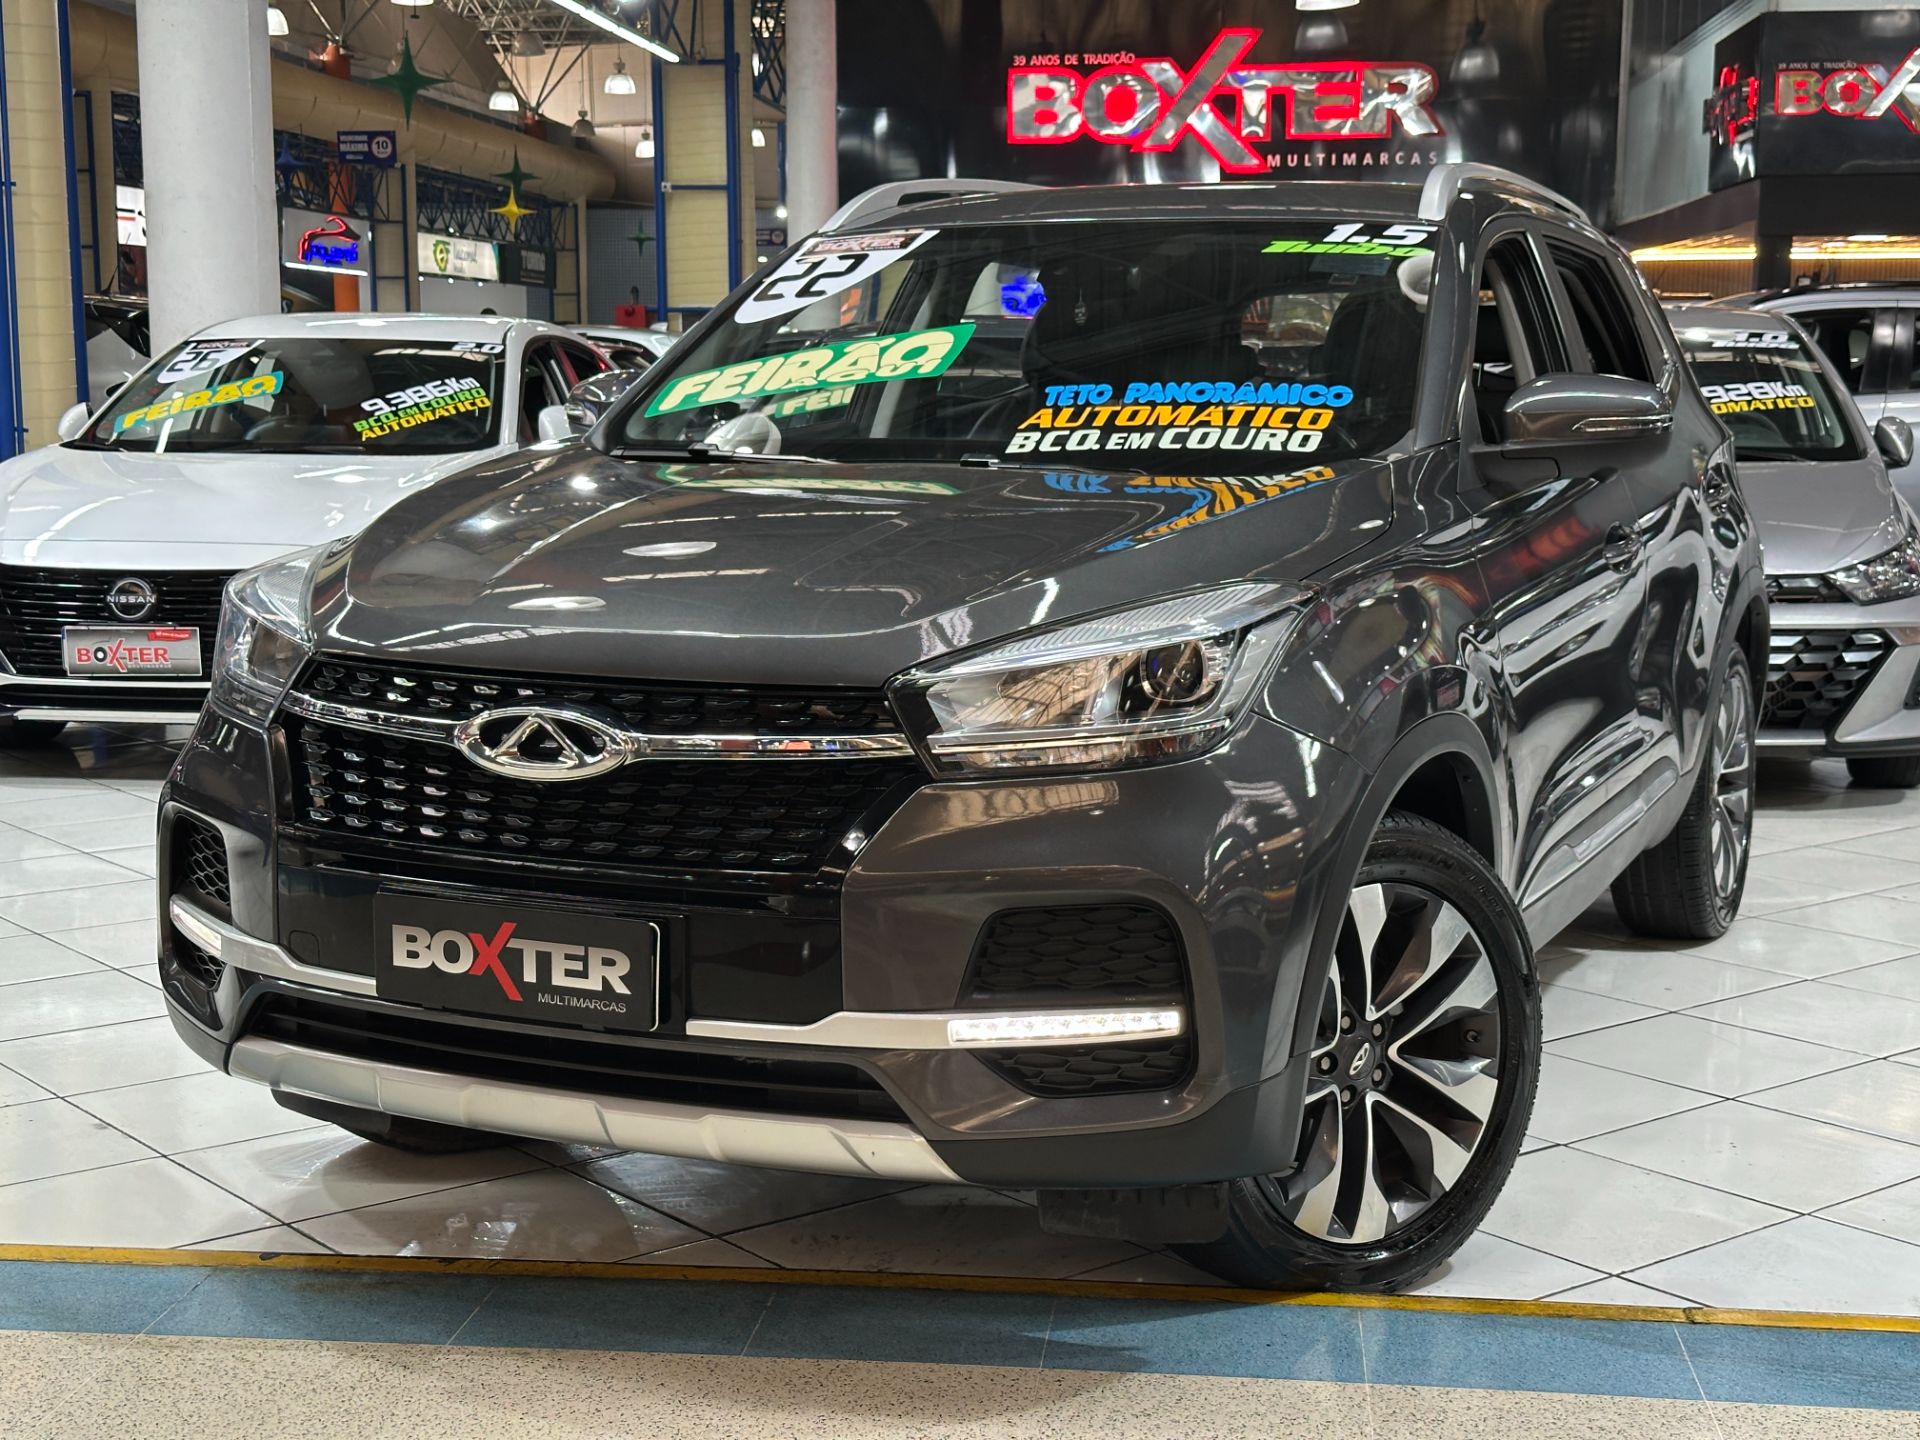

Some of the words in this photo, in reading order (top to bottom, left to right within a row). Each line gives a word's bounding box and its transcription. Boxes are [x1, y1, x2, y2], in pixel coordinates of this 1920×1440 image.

[1013, 55, 1026, 65] 39
[1030, 54, 1060, 65] ANOS
[1064, 54, 1079, 65] DE
[1084, 52, 1135, 66] TRADIÇÃO
[1007, 27, 1445, 173] BOXTER
[375, 140, 388, 150] 10
[1267, 152, 1438, 167] MULTIMARCAS
[1323, 223, 1438, 245] 1.5
[752, 252, 870, 302] 22
[452, 342, 504, 354] 2.0
[360, 377, 481, 416] 9.386Km
[399, 407, 419, 418] EM
[419, 387, 486, 411] COURO
[1045, 383, 1113, 407] TETO
[1105, 432, 1155, 450] EM
[1158, 426, 1323, 453] COURO
[106, 595, 156, 603] NISSAN
[76, 638, 169, 672] BOXTER
[391, 921, 632, 1002] BOXTER
[537, 992, 627, 1013] MULTIMARCAS
